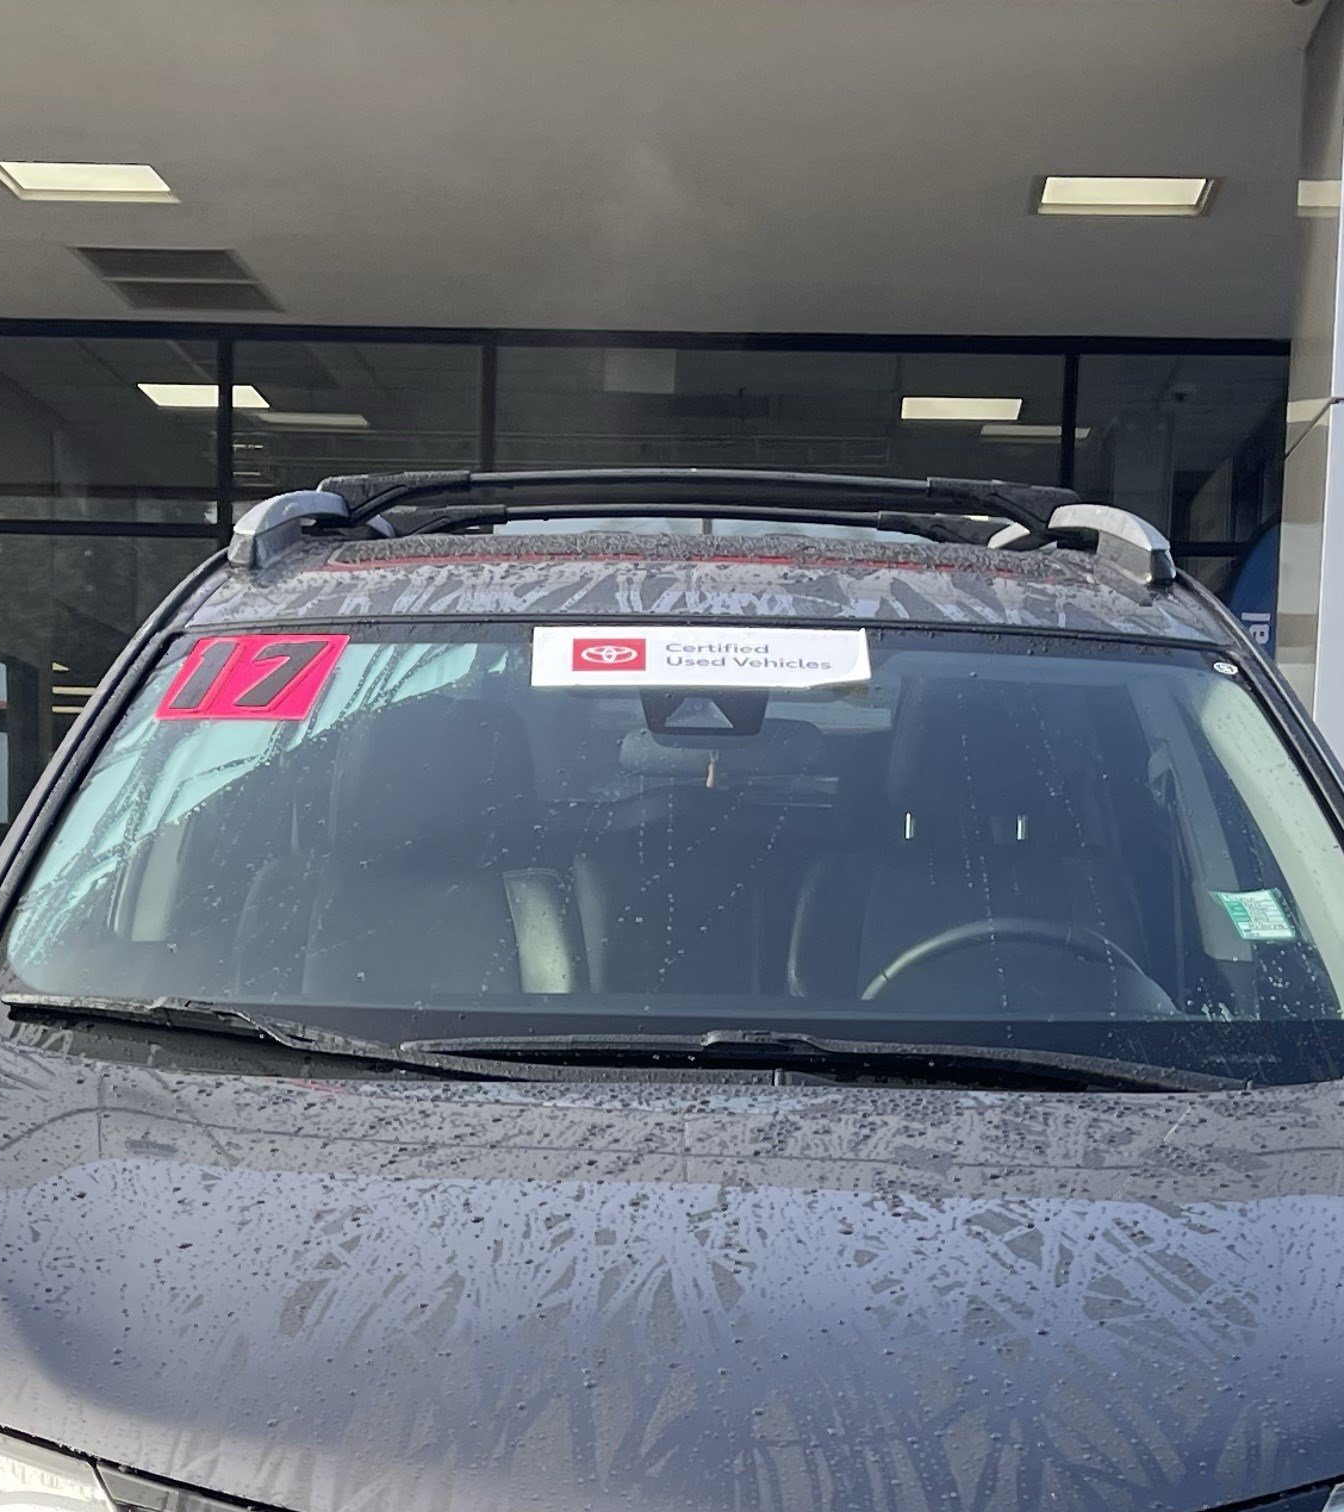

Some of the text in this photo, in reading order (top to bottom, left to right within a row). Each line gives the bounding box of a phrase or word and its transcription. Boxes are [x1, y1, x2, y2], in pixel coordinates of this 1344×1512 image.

[665, 642, 770, 654] Certified
[665, 656, 832, 670] Used Vehicles
[168, 640, 330, 710] 17
